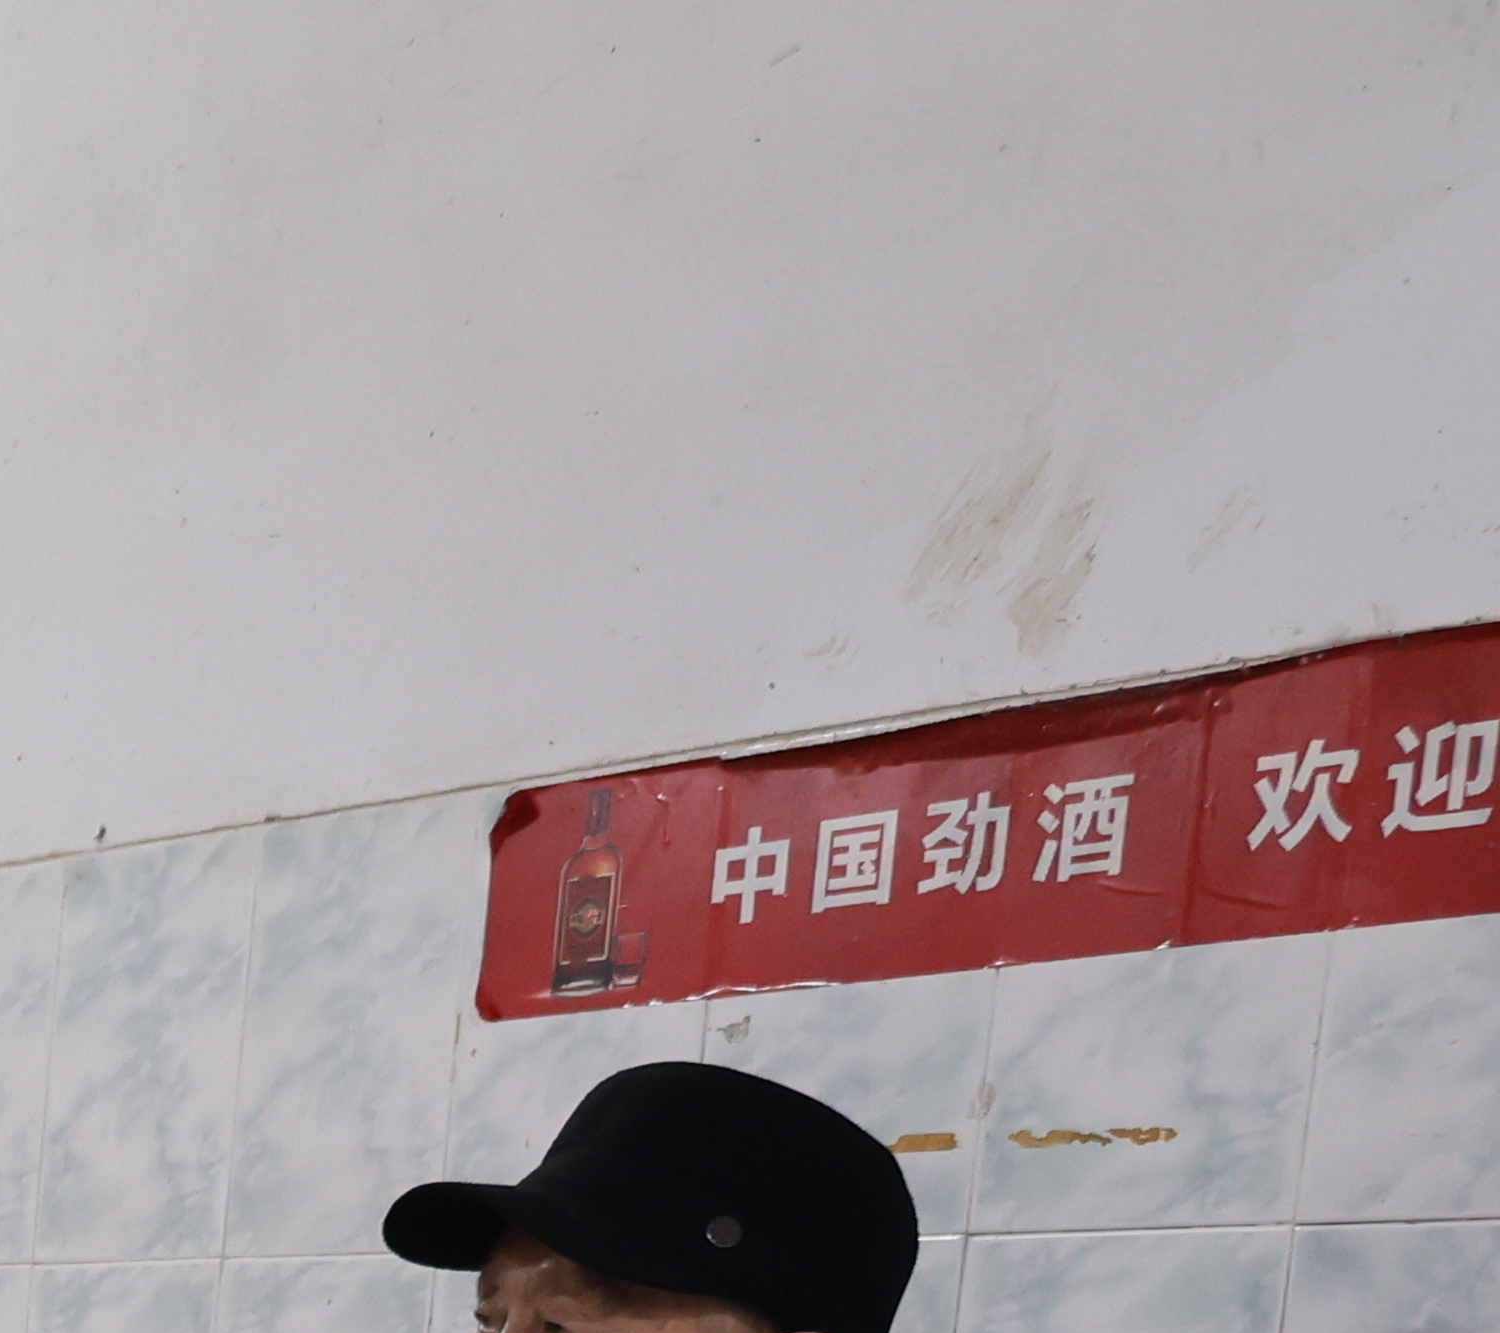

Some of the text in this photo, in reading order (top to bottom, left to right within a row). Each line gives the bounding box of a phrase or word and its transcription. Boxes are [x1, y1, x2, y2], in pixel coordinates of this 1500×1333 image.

[709, 718, 1500, 926] 中国劲酒 欢迎
